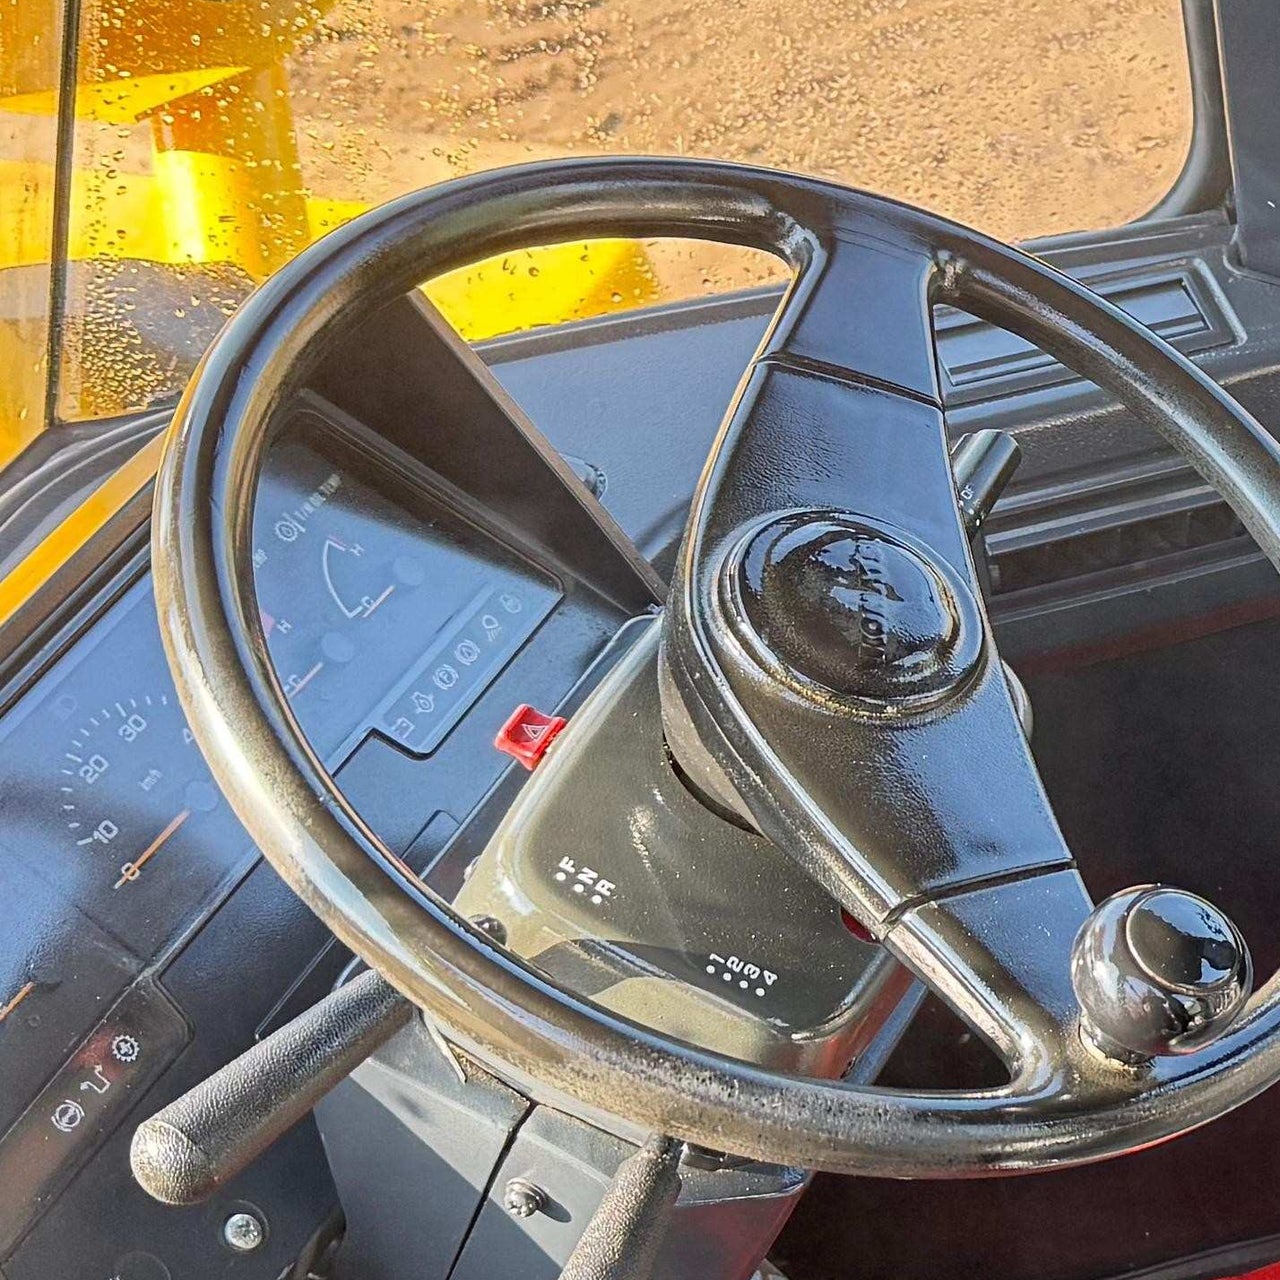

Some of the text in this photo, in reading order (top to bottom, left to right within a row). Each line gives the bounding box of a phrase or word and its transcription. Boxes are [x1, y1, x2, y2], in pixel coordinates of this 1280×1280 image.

[349, 543, 365, 557] H
[277, 619, 292, 634] H
[118, 714, 147, 742] 30
[79, 754, 109, 784] 20
[93, 820, 119, 844] 10
[558, 856, 575, 873] F
[576, 867, 599, 885] N
[594, 879, 616, 896] R
[726, 956, 745, 972] 2
[762, 970, 778, 986] 4
